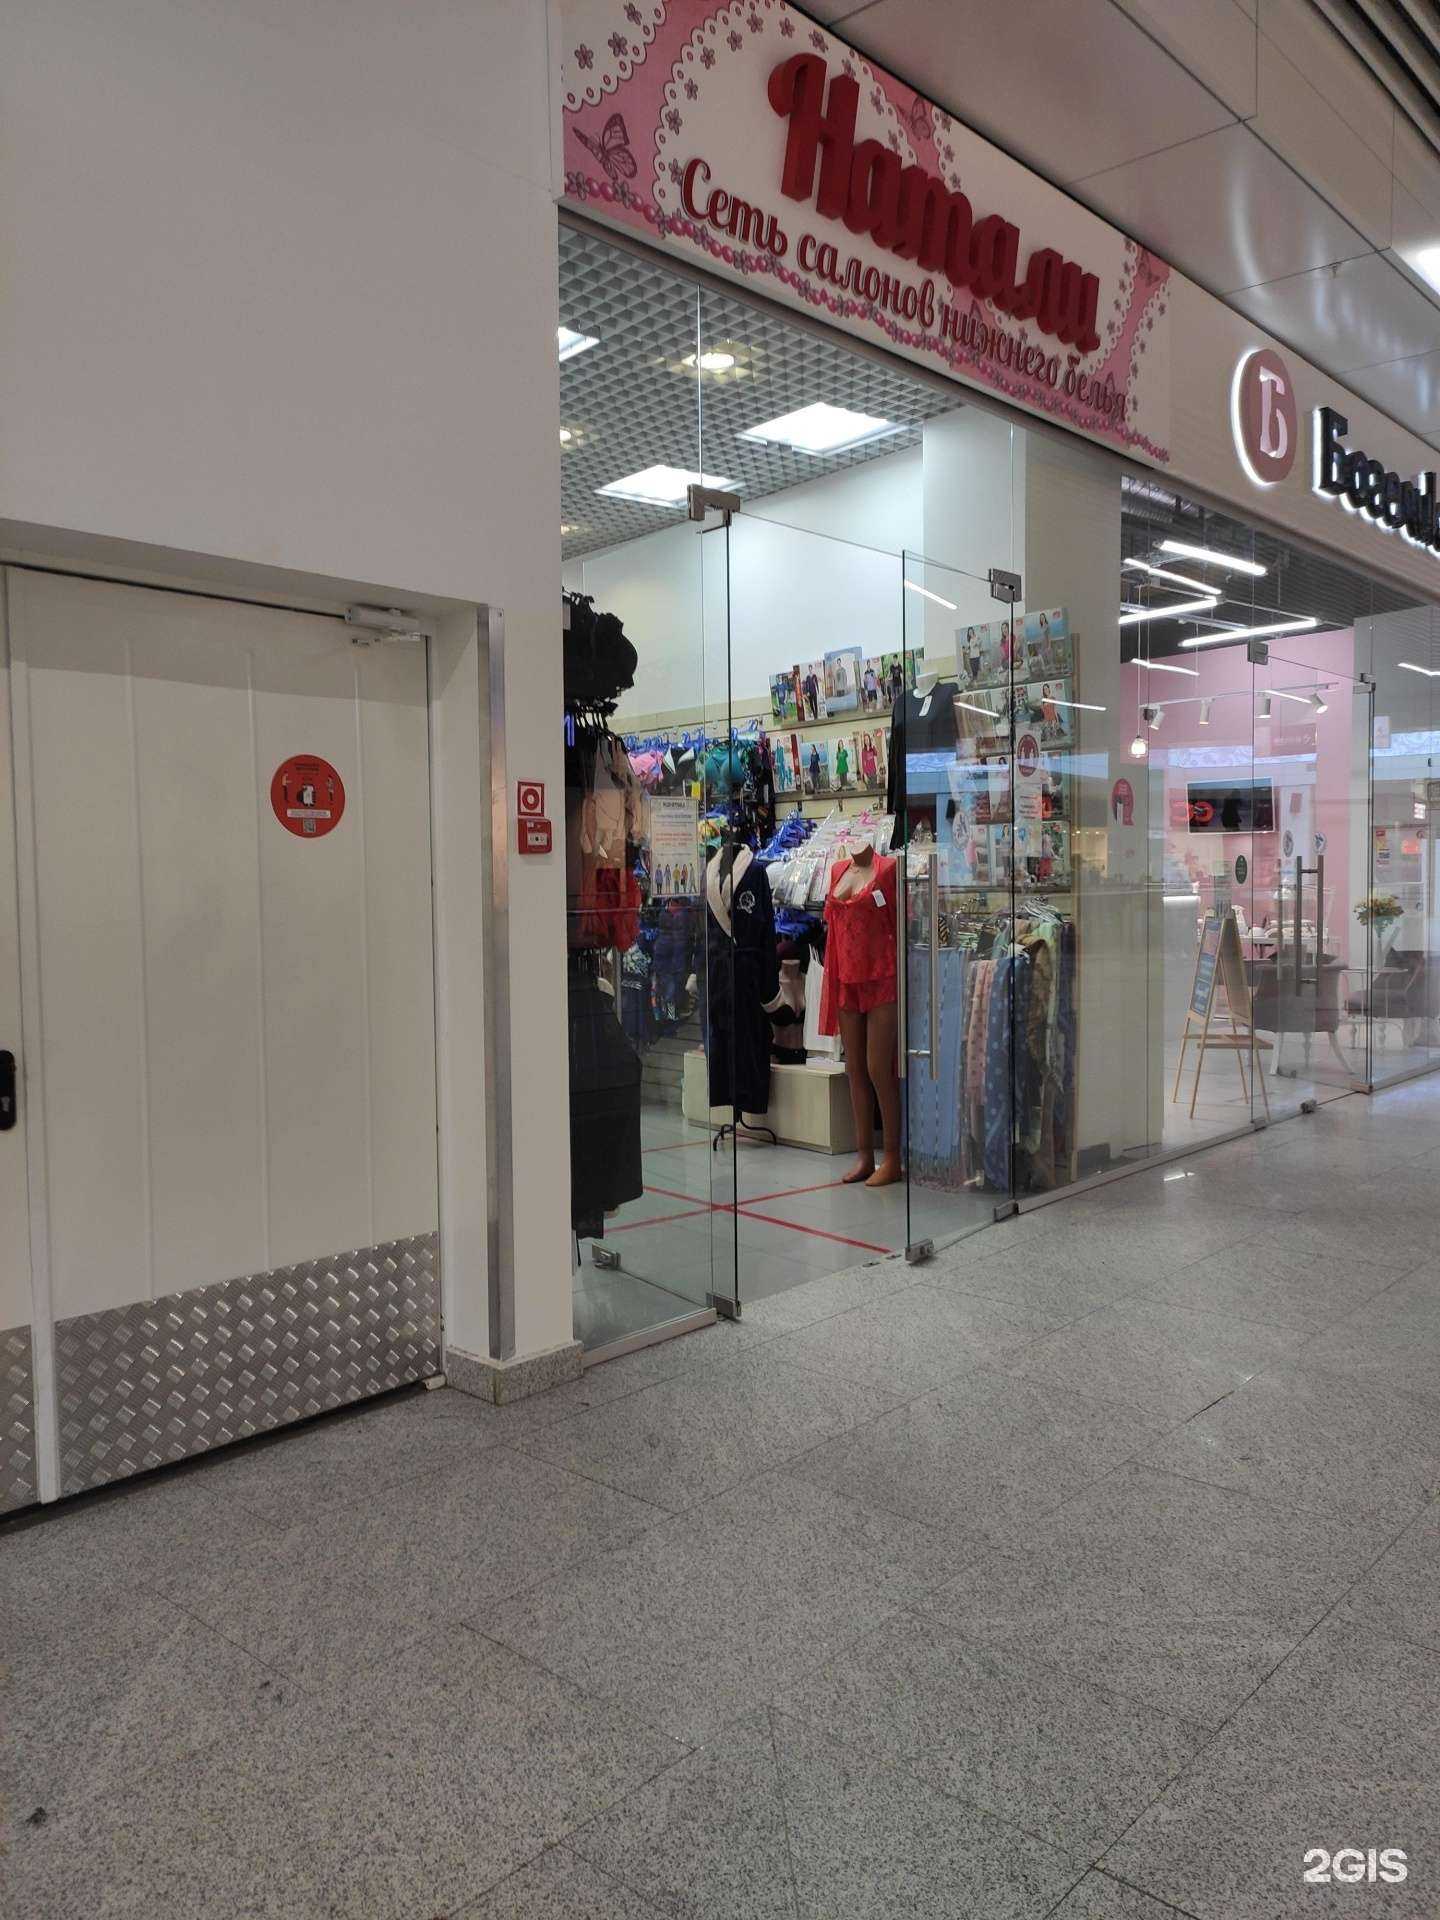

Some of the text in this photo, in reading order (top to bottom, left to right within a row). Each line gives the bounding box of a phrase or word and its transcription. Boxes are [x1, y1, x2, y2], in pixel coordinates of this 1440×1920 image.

[681, 158, 1127, 421] Сеть салонов нижнего белья
[768, 52, 1100, 353] Натали
